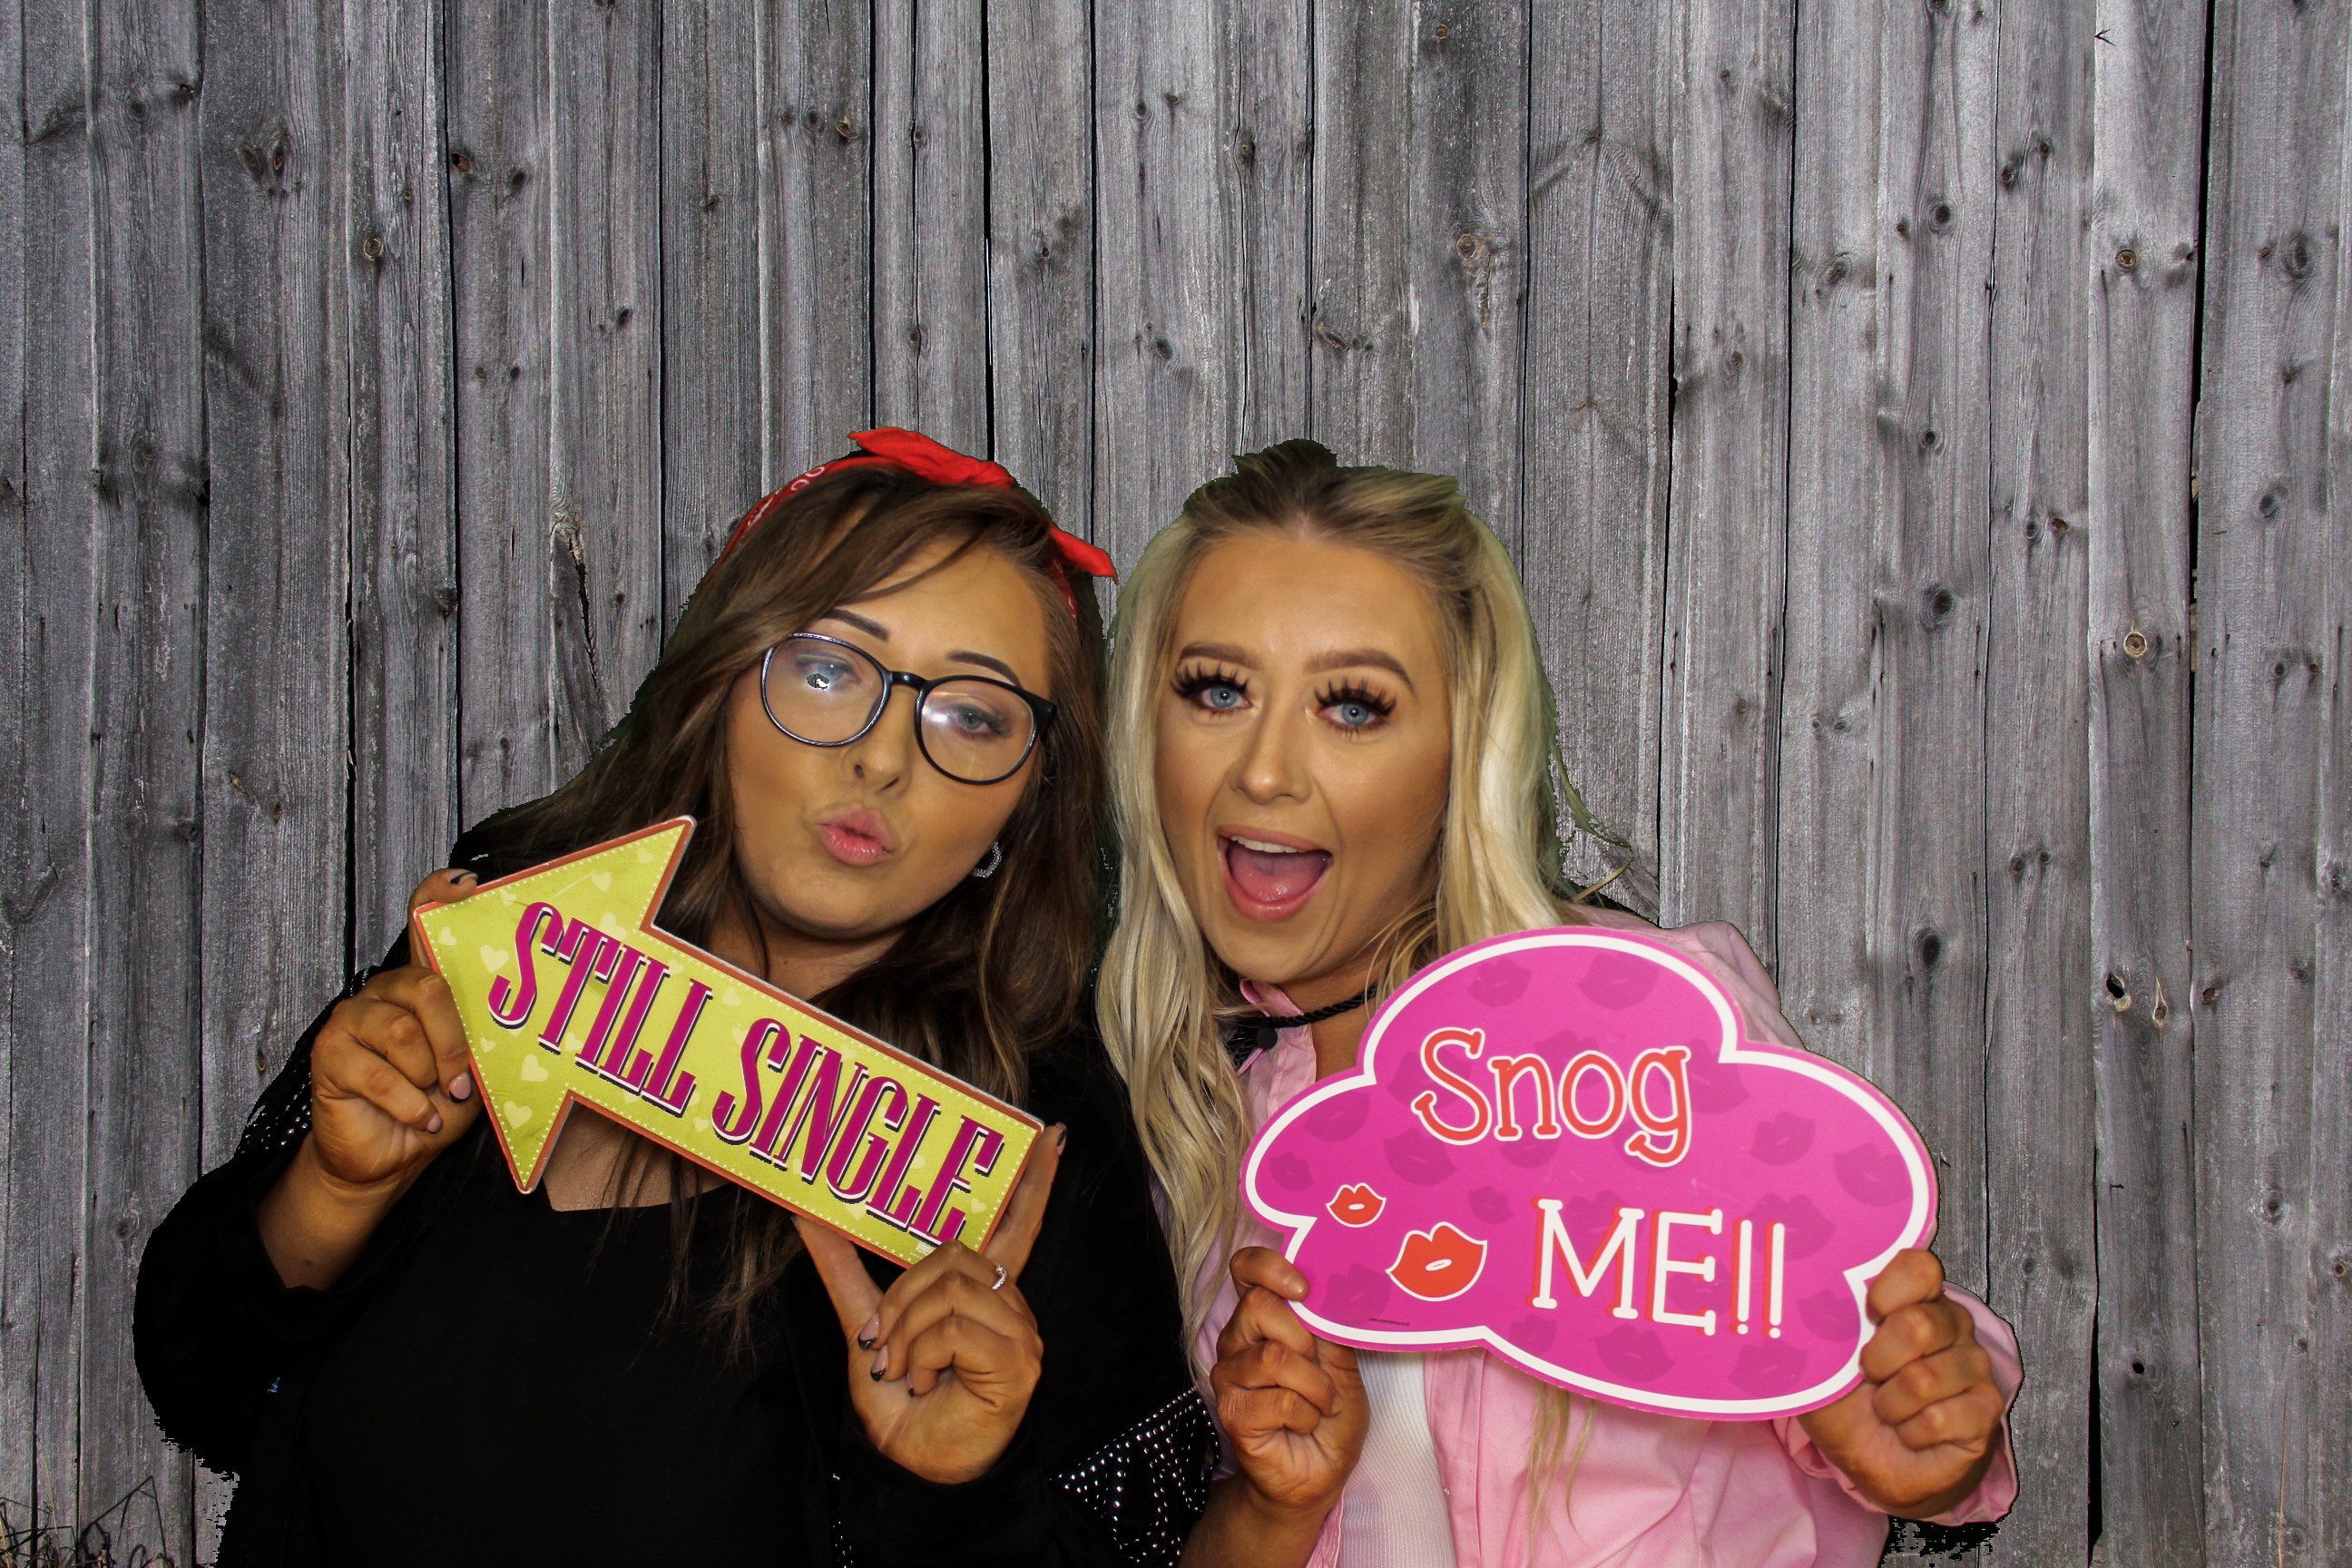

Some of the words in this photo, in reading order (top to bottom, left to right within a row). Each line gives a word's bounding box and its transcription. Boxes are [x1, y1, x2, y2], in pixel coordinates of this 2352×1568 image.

[487, 902, 713, 1116] STILL
[711, 1017, 1004, 1247] SINGLE
[1411, 1027, 1690, 1168] Snog
[1528, 1196, 1786, 1338] ME!!
